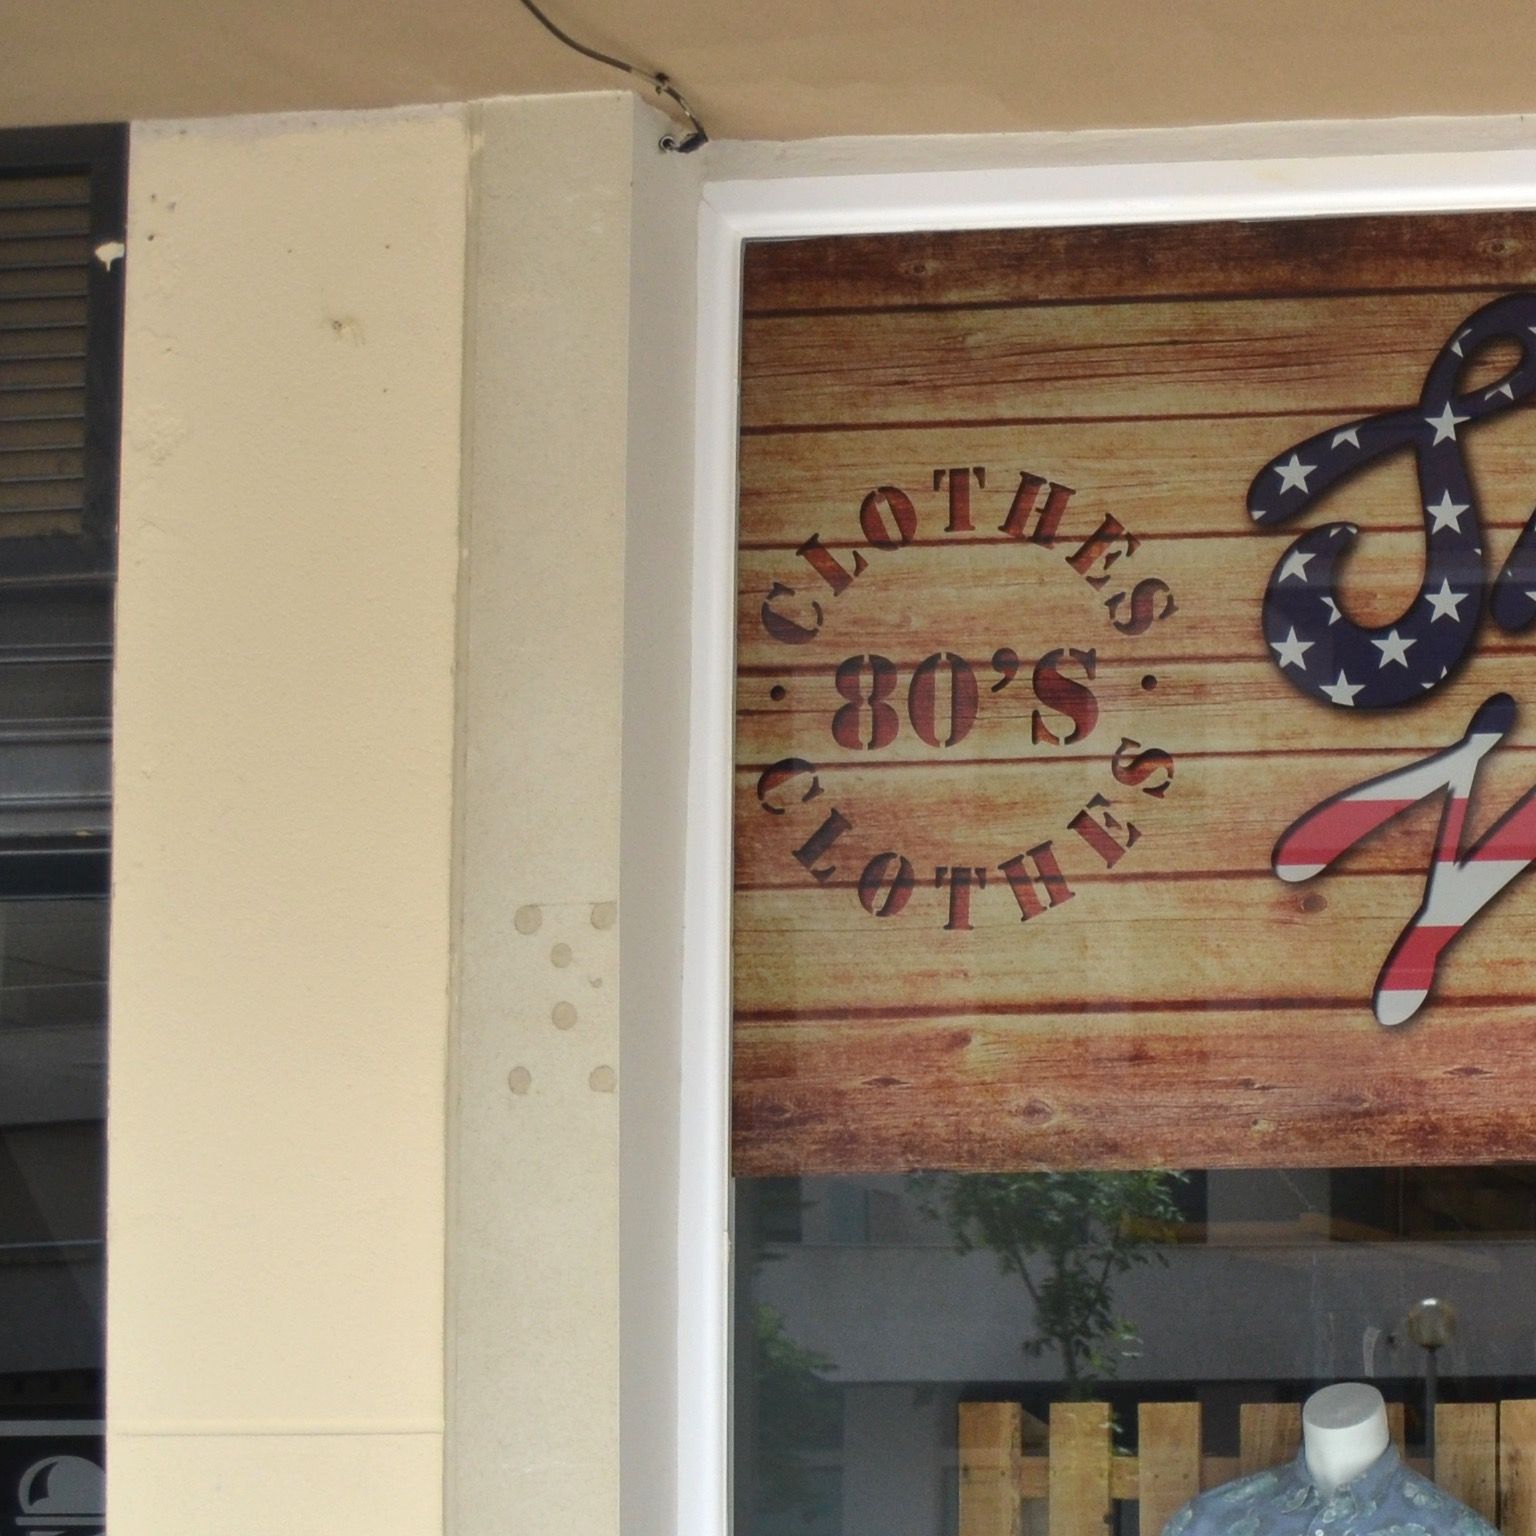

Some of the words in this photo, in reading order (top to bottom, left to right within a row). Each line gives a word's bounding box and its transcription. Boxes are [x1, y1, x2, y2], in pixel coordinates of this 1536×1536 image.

[761, 466, 1178, 645] CLOTHES
[831, 647, 1100, 751] 80'S
[757, 736, 1175, 931] CLOTHES
